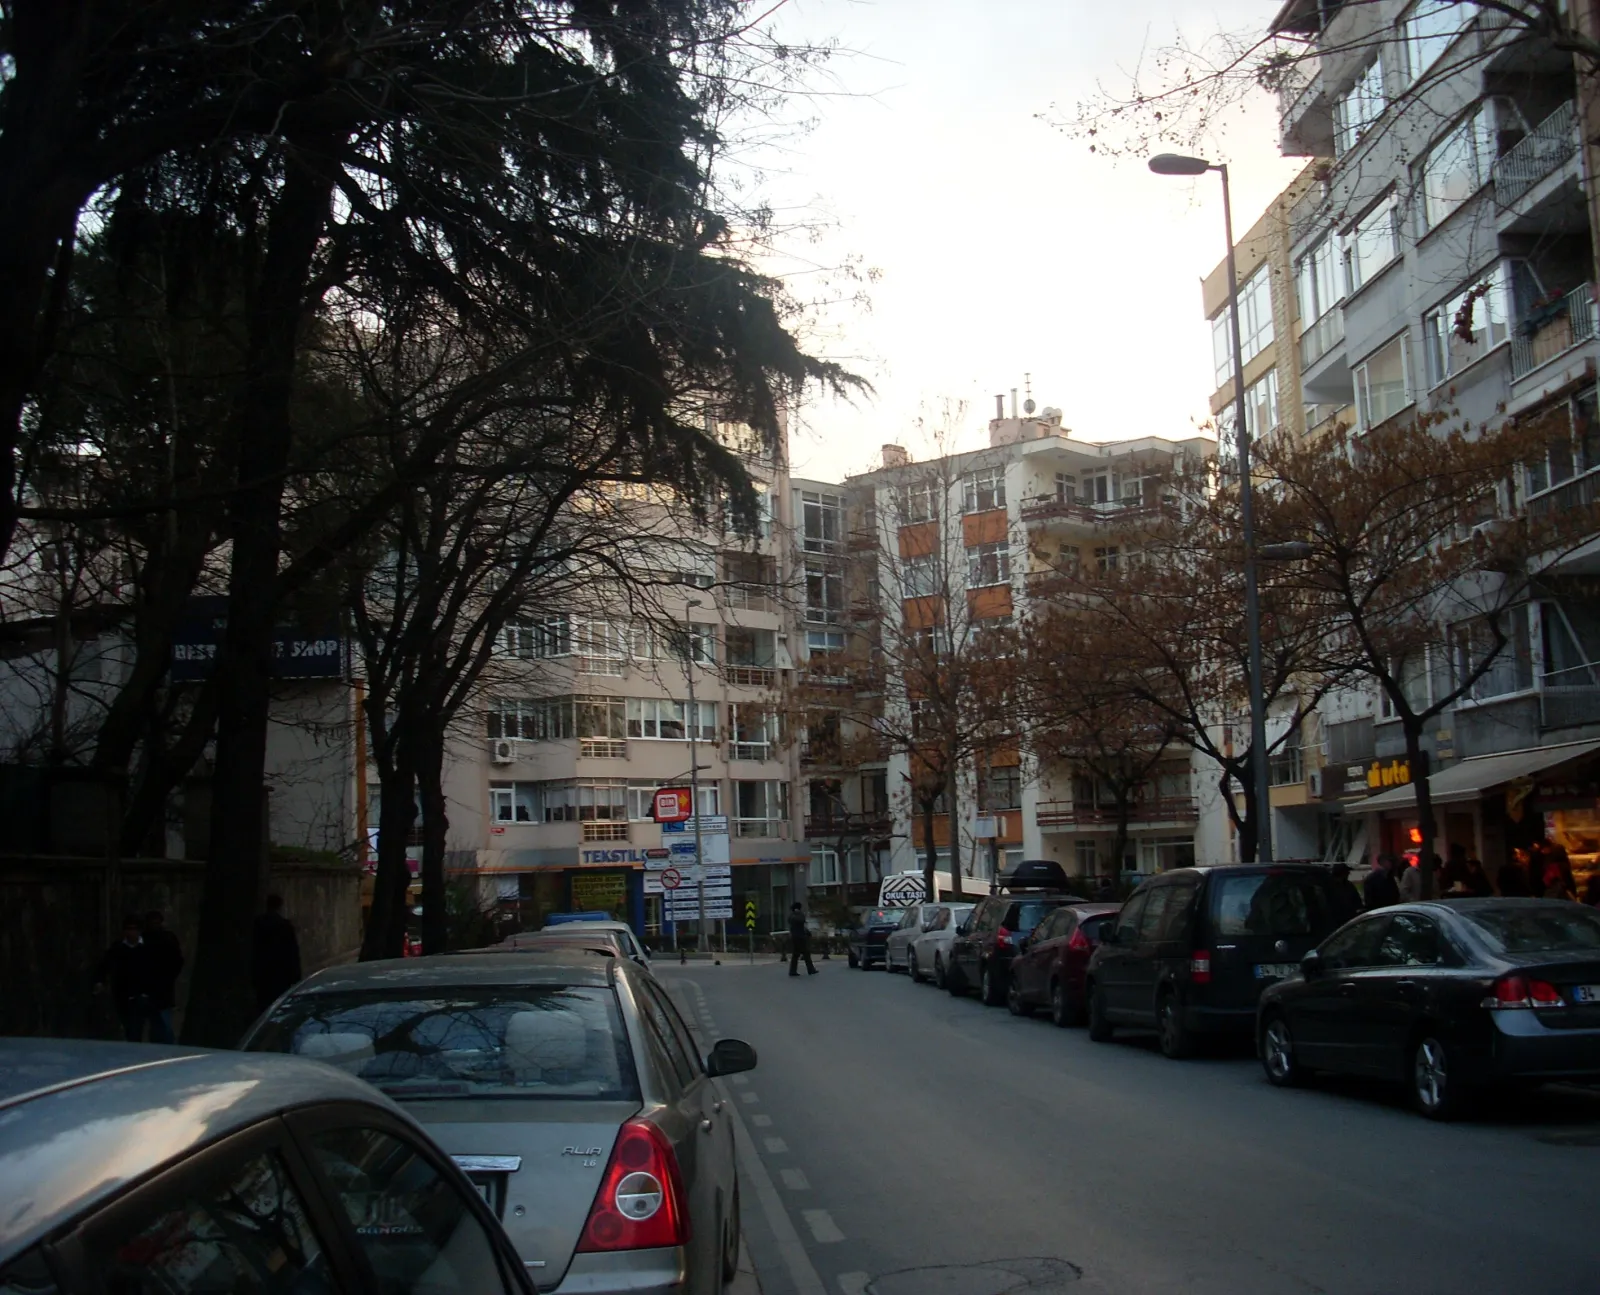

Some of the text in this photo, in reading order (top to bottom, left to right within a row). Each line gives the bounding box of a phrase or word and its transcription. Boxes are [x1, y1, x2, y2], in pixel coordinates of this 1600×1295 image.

[290, 640, 338, 657] SHOP
[885, 892, 905, 900] OKUL
[1580, 986, 1595, 1000] 34
